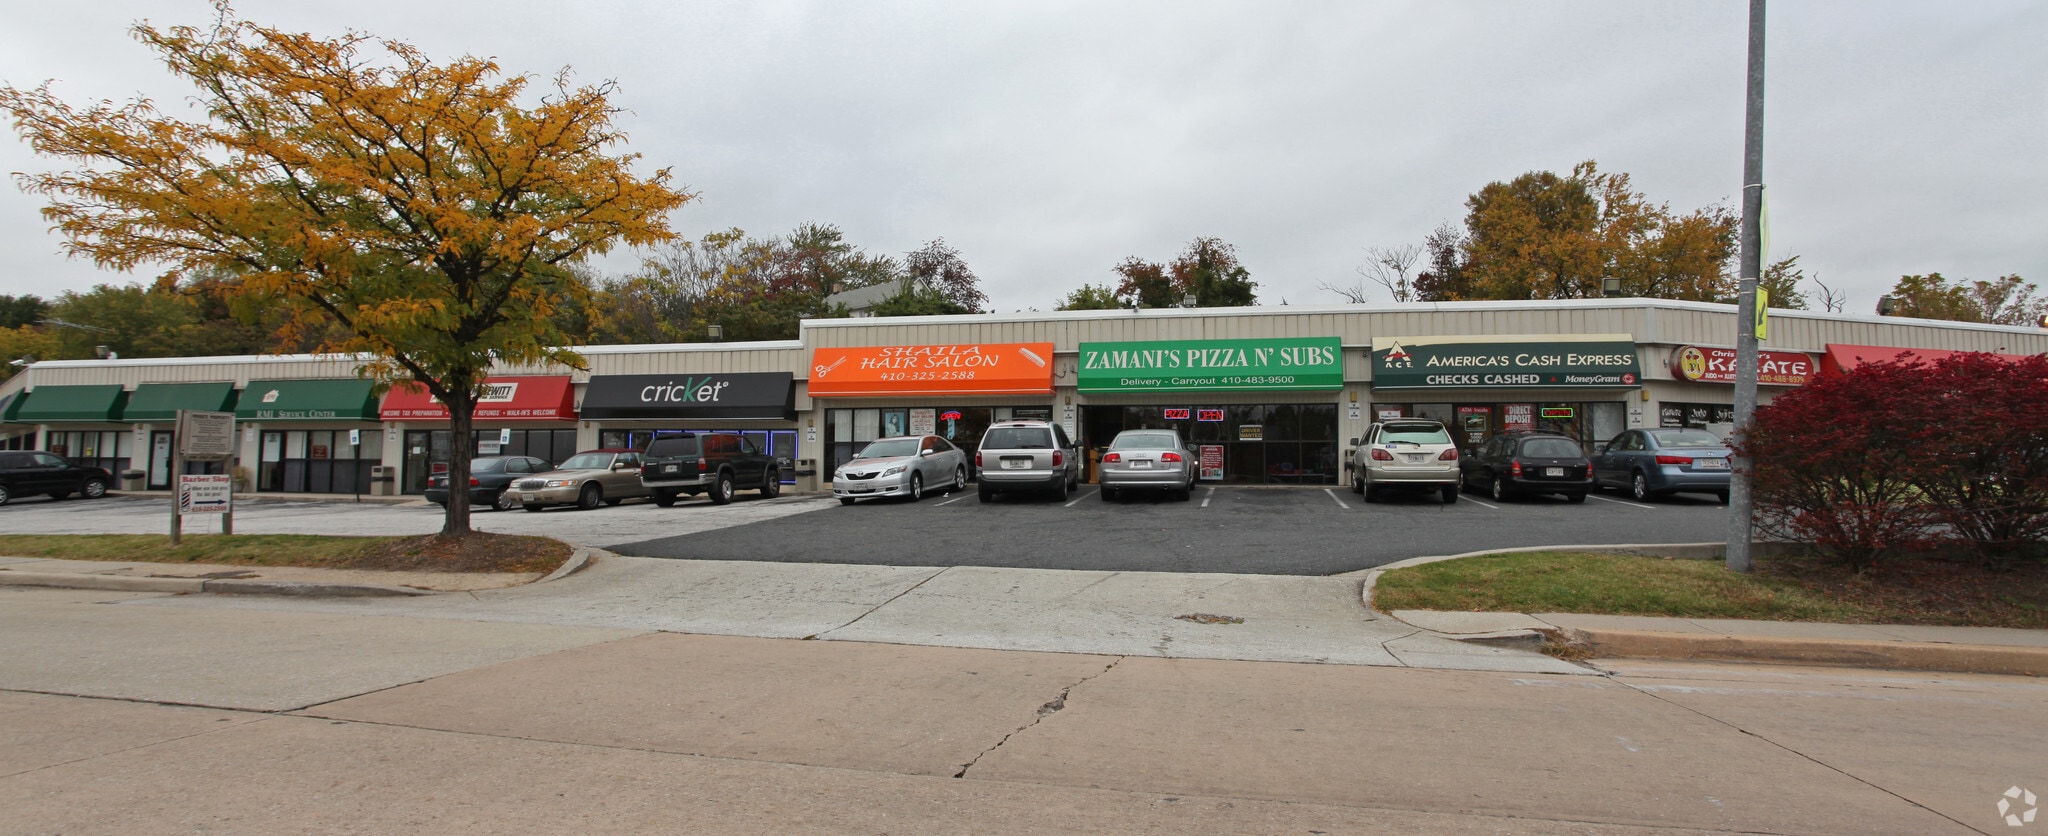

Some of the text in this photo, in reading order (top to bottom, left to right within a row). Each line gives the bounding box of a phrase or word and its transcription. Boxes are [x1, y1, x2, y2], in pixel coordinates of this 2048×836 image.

[879, 346, 980, 357] SHAILA
[1711, 350, 1735, 358] Chris
[860, 354, 999, 370] HAIR SALON
[1085, 346, 1335, 369] ZAMANI'S PIZZA N' SUBS
[1425, 353, 1632, 367] AMERICA'S CASH EXPRESS
[1708, 357, 1807, 375] KAATE
[880, 371, 976, 381] 410-325-2588
[1120, 378, 1162, 387] Delivery
[1171, 376, 1216, 387] Carryout
[1221, 375, 1295, 385] 410-483-9500
[1426, 374, 1620, 385] CHECKS CASHED MoneyGram
[481, 385, 512, 396] EWITT
[278, 410, 305, 418] SERVICE
[309, 409, 336, 417] CENTER
[1166, 409, 1189, 418] PIZZA
[1198, 410, 1223, 420] OPEN
[1509, 405, 1531, 415] DIRECT
[940, 413, 961, 421] OPEN
[1505, 415, 1531, 424] DEPOSIT
